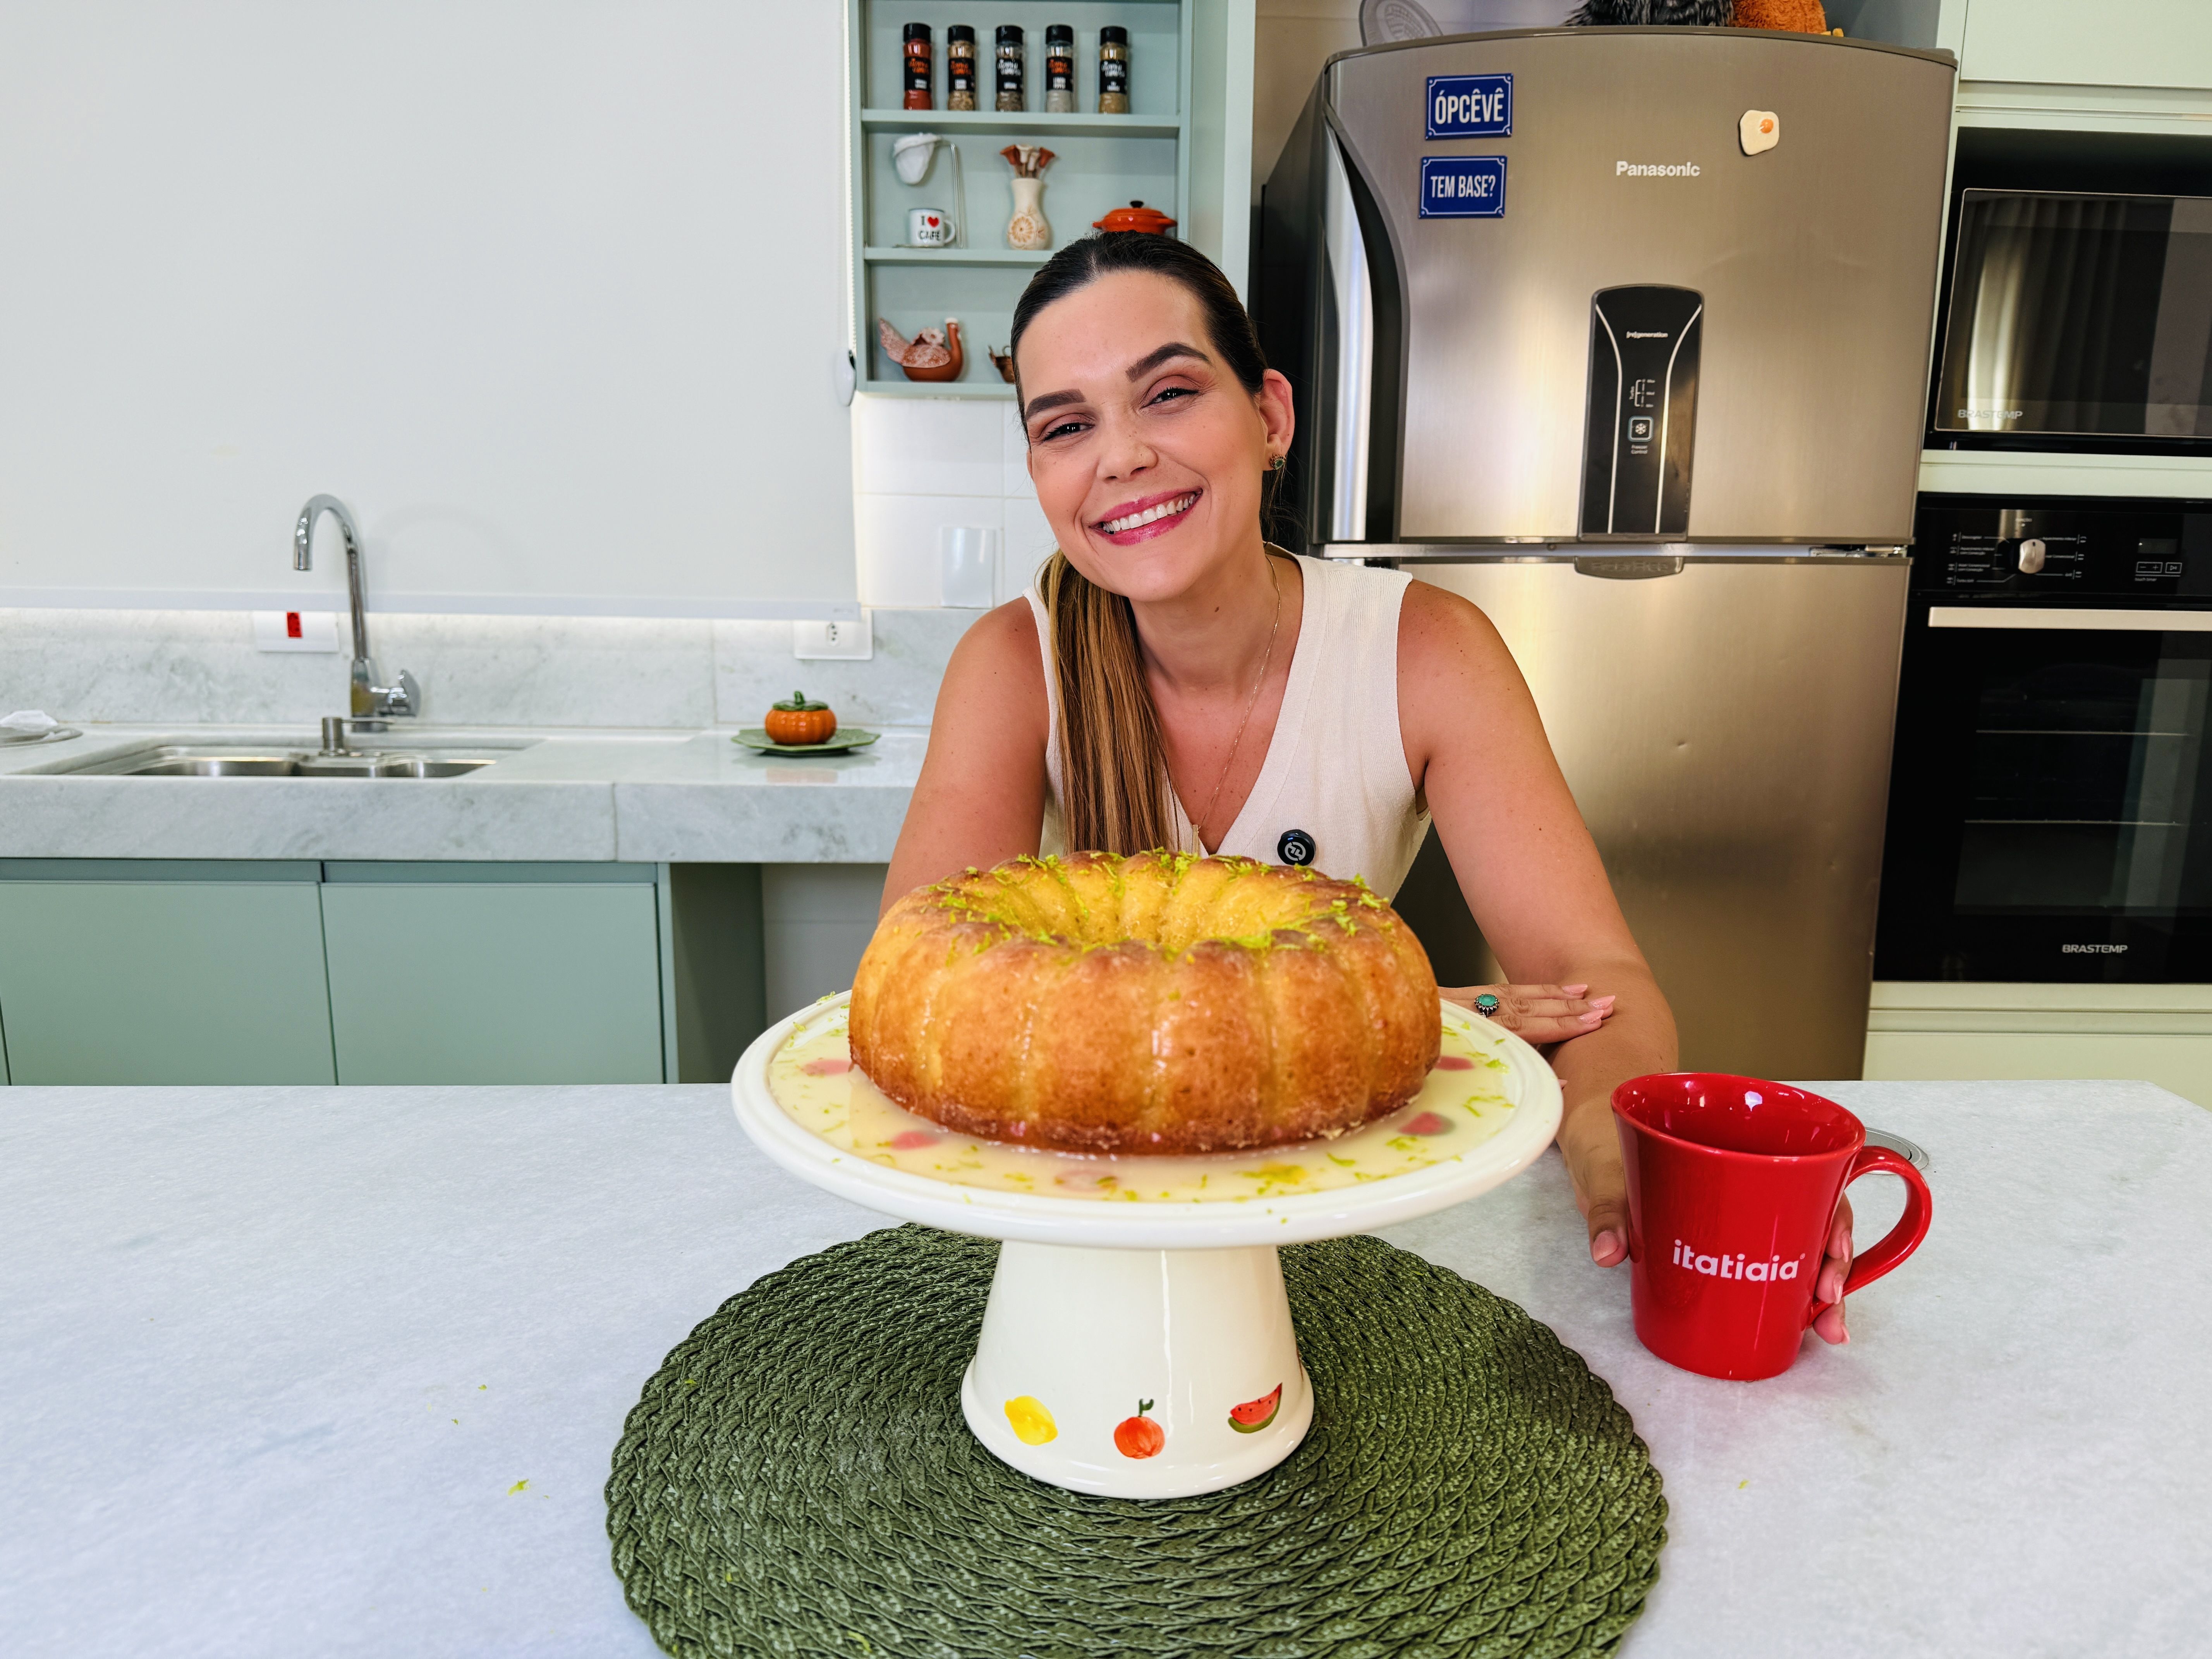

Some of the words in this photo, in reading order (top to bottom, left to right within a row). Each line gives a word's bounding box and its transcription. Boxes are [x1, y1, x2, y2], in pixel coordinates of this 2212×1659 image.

[1435, 88, 1504, 124] ÓPCÊVÊ
[1616, 161, 1700, 177] Panasonic
[1430, 175, 1455, 198] TEM
[1458, 174, 1496, 198] BASE?
[921, 215, 925, 225] I
[1958, 409, 2023, 419] BRASTEMP
[2062, 944, 2128, 953] BRASTEMP
[1673, 1239, 1799, 1281] itatiaia
